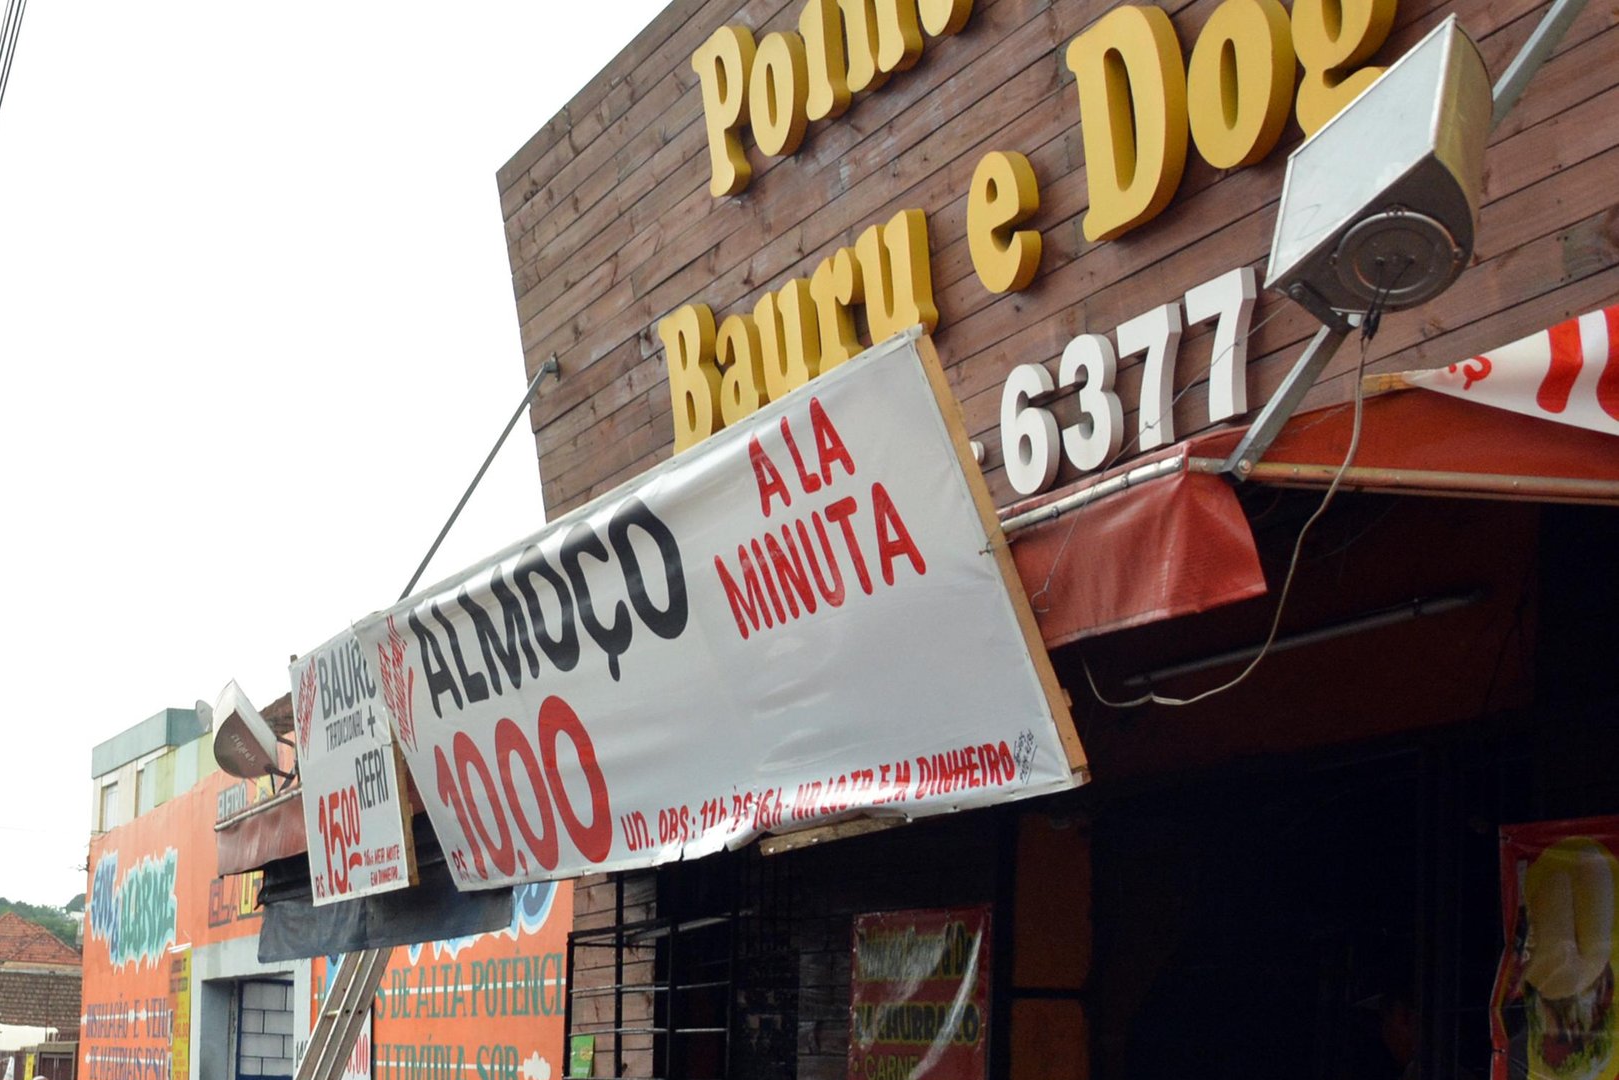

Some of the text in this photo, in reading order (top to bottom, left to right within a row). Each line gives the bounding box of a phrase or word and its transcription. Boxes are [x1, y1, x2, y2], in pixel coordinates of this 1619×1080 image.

[658, 209, 939, 456] Bauru
[967, 150, 1042, 293] e
[780, 397, 856, 494] LA
[1000, 268, 1257, 497] 6377
[408, 496, 690, 720] ALMOÇO
[714, 482, 927, 640] MINUTA
[355, 748, 389, 811] REFRI
[915, 741, 1015, 800] DINHEIRO
[391, 967, 413, 1019] DE
[415, 959, 465, 1019] ALTA
[471, 948, 565, 1018] POTÊNCI
